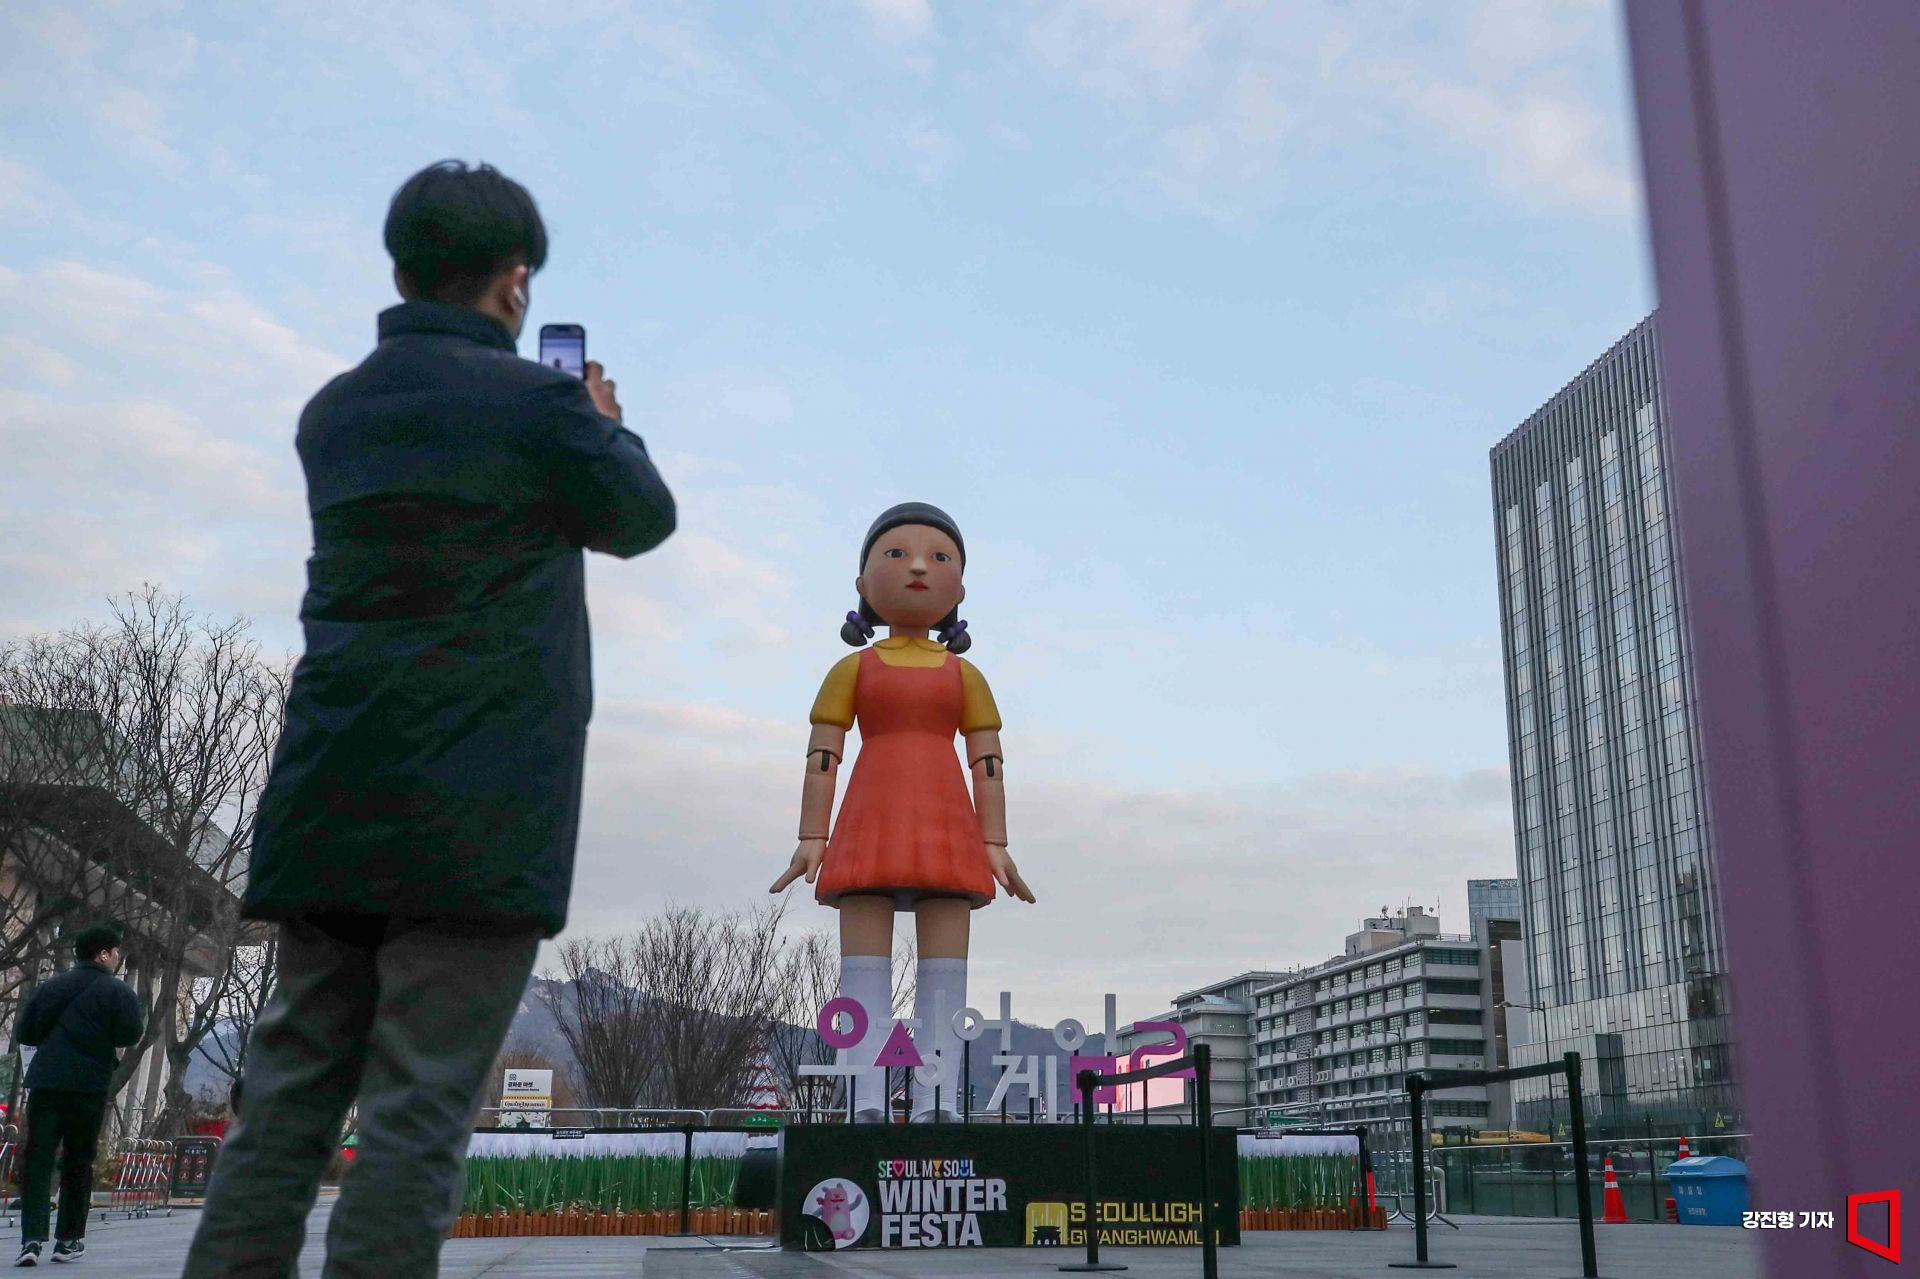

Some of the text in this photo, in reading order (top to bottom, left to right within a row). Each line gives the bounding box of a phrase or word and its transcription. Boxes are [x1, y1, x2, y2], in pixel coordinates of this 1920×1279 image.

[798, 989, 1011, 1087] 오징어
[944, 1159, 976, 1178] SOUL
[878, 1178, 1008, 1213] WINTER
[1071, 1202, 1219, 1222] SOULLIGH
[882, 1213, 984, 1248] FESTA
